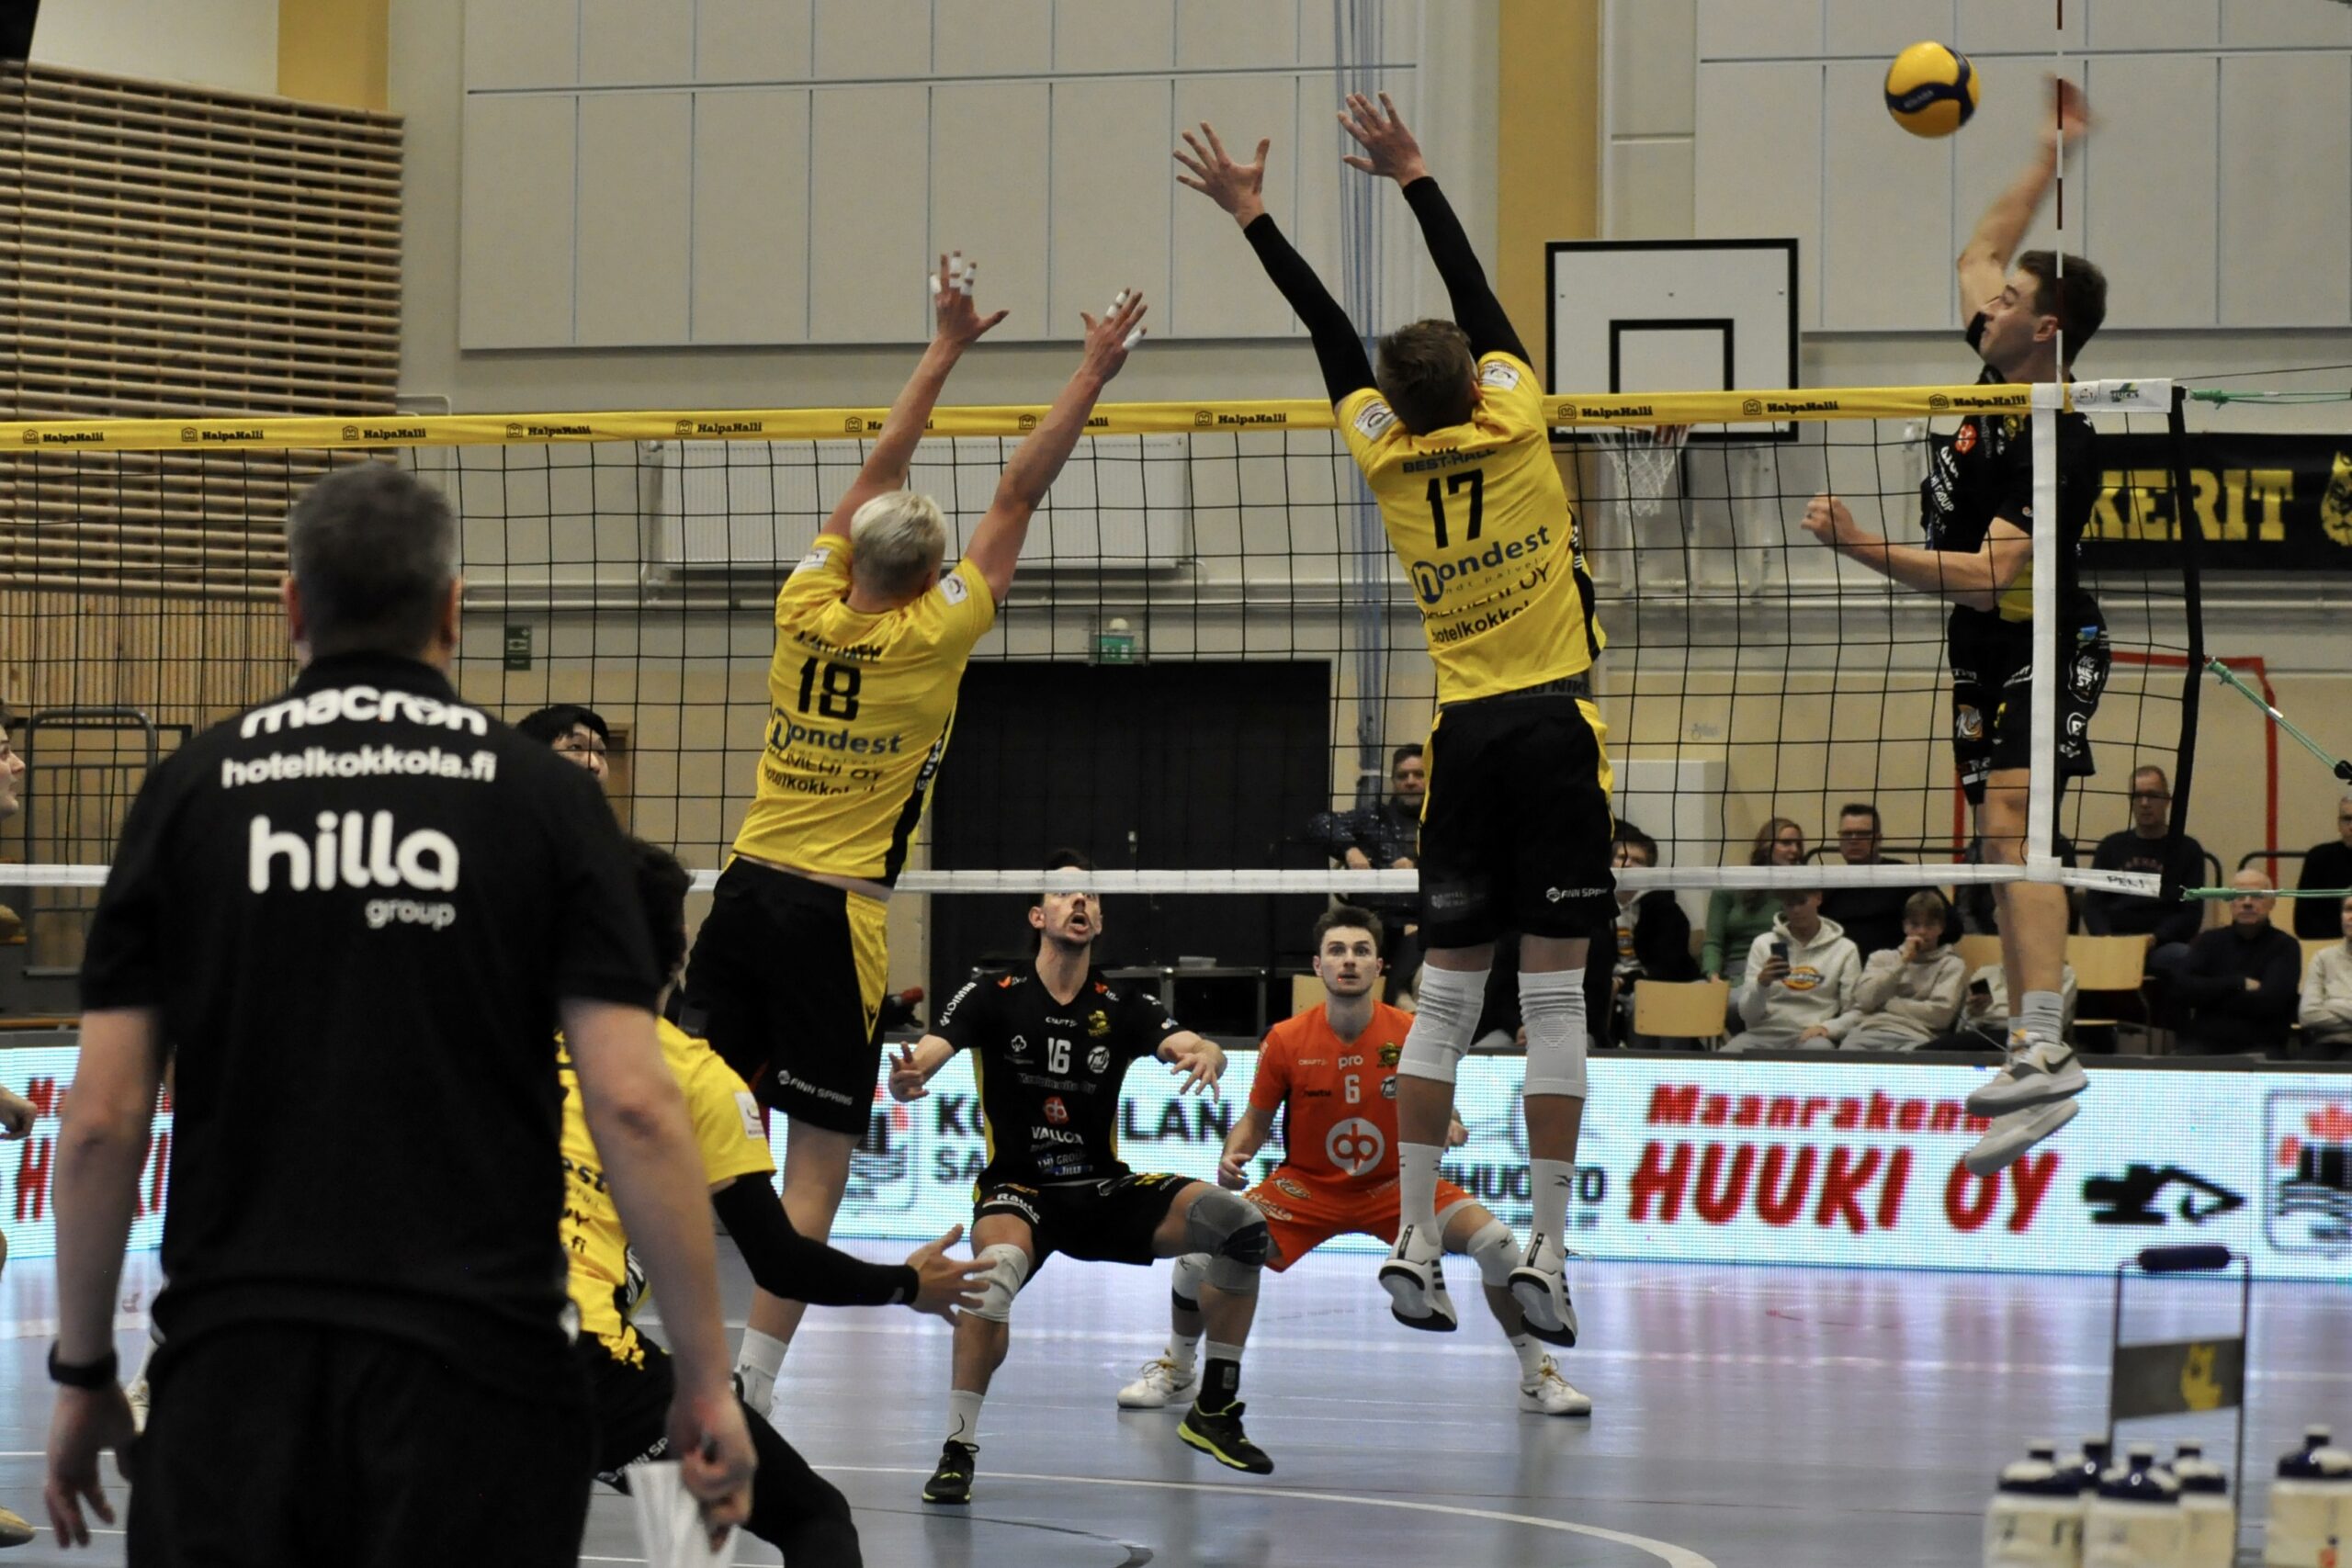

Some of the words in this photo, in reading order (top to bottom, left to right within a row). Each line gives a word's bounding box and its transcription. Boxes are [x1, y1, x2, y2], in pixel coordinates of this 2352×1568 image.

[697, 422, 763, 434] HalpaHalli
[1217, 413, 1287, 425] HalpaHalli
[1582, 406, 1653, 419] HalpaHalli
[42, 432, 105, 443] HalpaHalli
[202, 430, 265, 441] HalpaHalli
[363, 428, 427, 439] HalpaHalli
[1426, 468, 1484, 549] 17
[797, 656, 862, 721] 18
[239, 684, 489, 739] macron
[221, 744, 498, 789] hotelkokkola.fi
[249, 809, 460, 895] hilla
[366, 899, 457, 932] group
[1047, 1036, 1071, 1075] 16
[1338, 1054, 1363, 1071] pro
[1344, 1074, 1361, 1104] 6
[1627, 1140, 1916, 1235] HUUKI
[1942, 1150, 2060, 1235] OY
